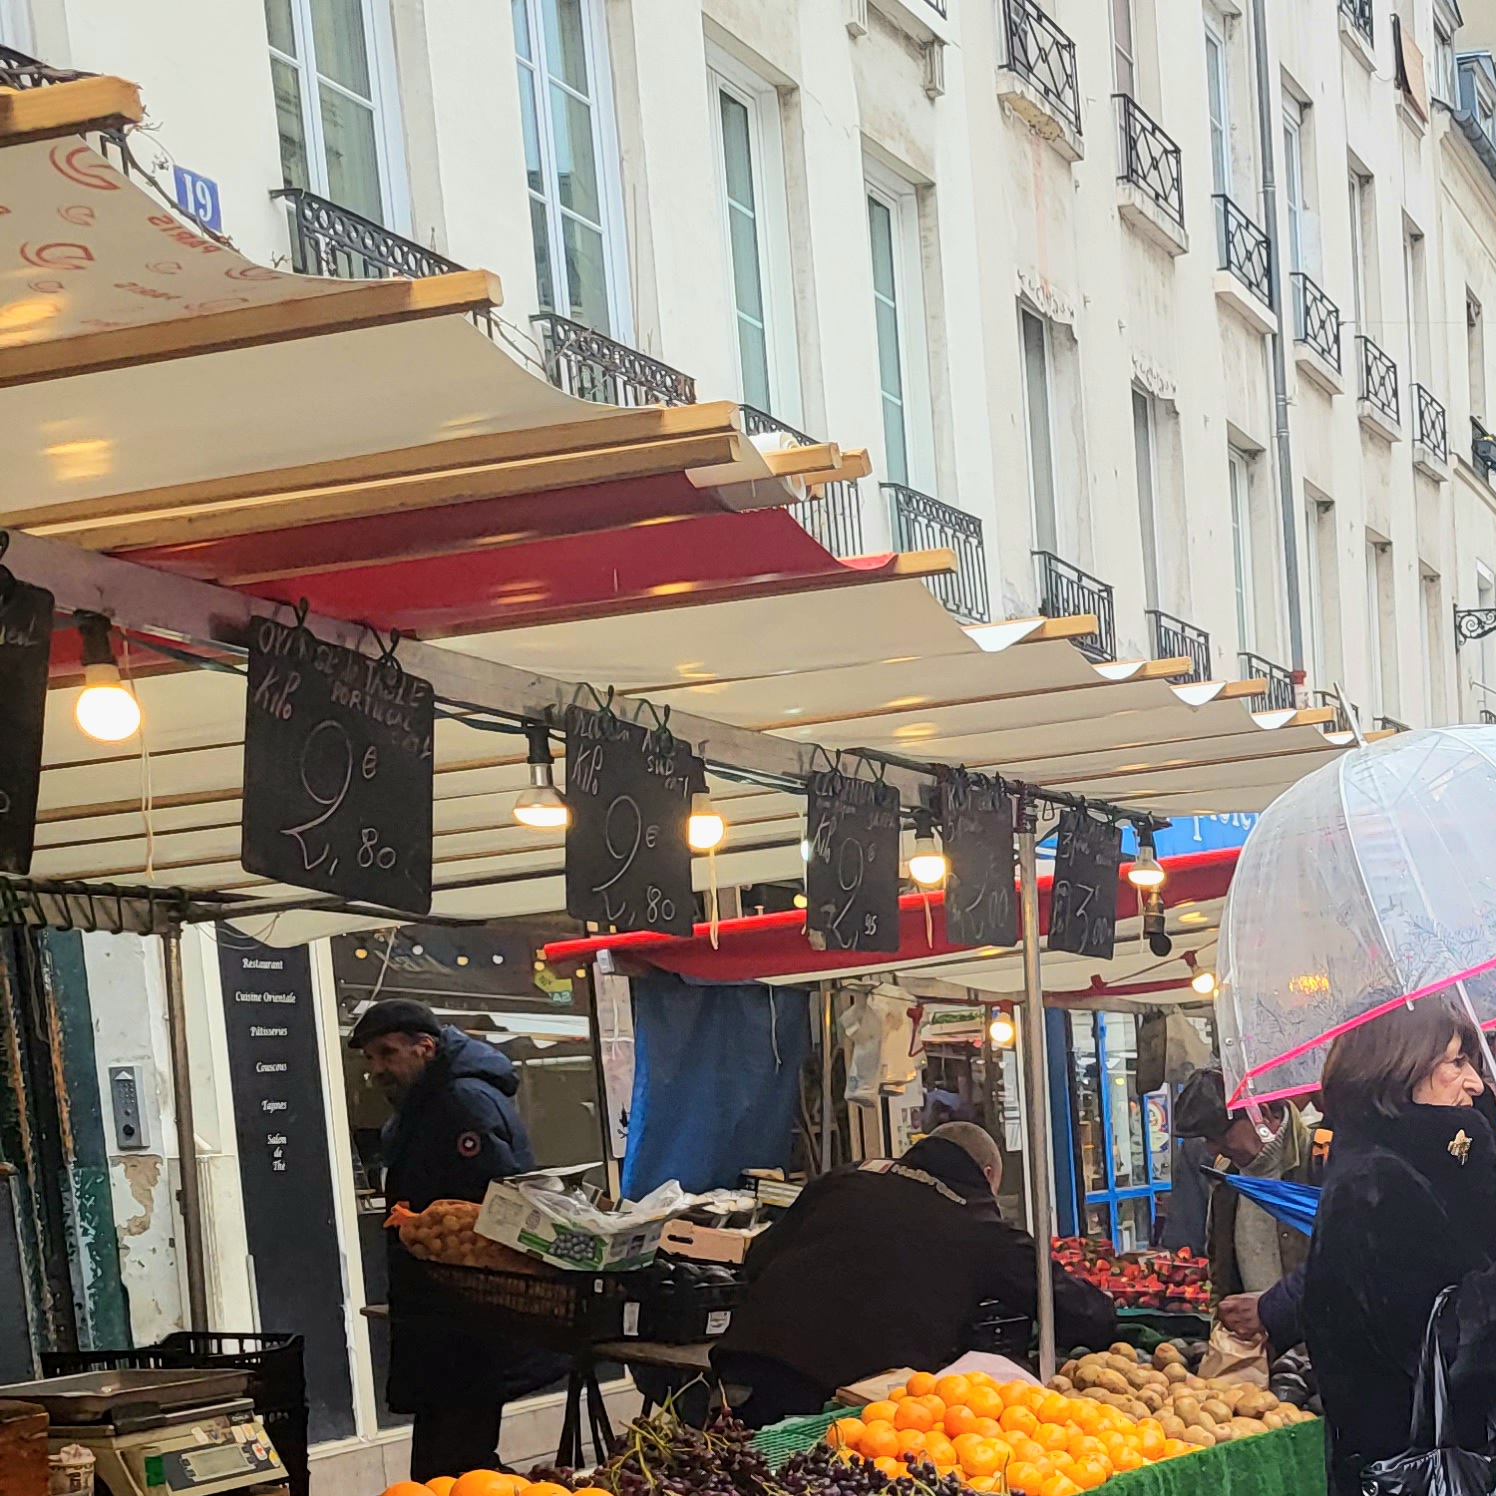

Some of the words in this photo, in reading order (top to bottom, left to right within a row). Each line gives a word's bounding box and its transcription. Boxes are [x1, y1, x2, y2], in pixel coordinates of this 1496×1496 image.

[184, 172, 213, 222] 19
[242, 958, 284, 970] Restaurant
[235, 991, 262, 1002] Cuisine
[263, 991, 296, 1004] Orientale
[256, 1061, 287, 1073] Couscous
[267, 1133, 288, 1145] Salon
[273, 1146, 283, 1158] de
